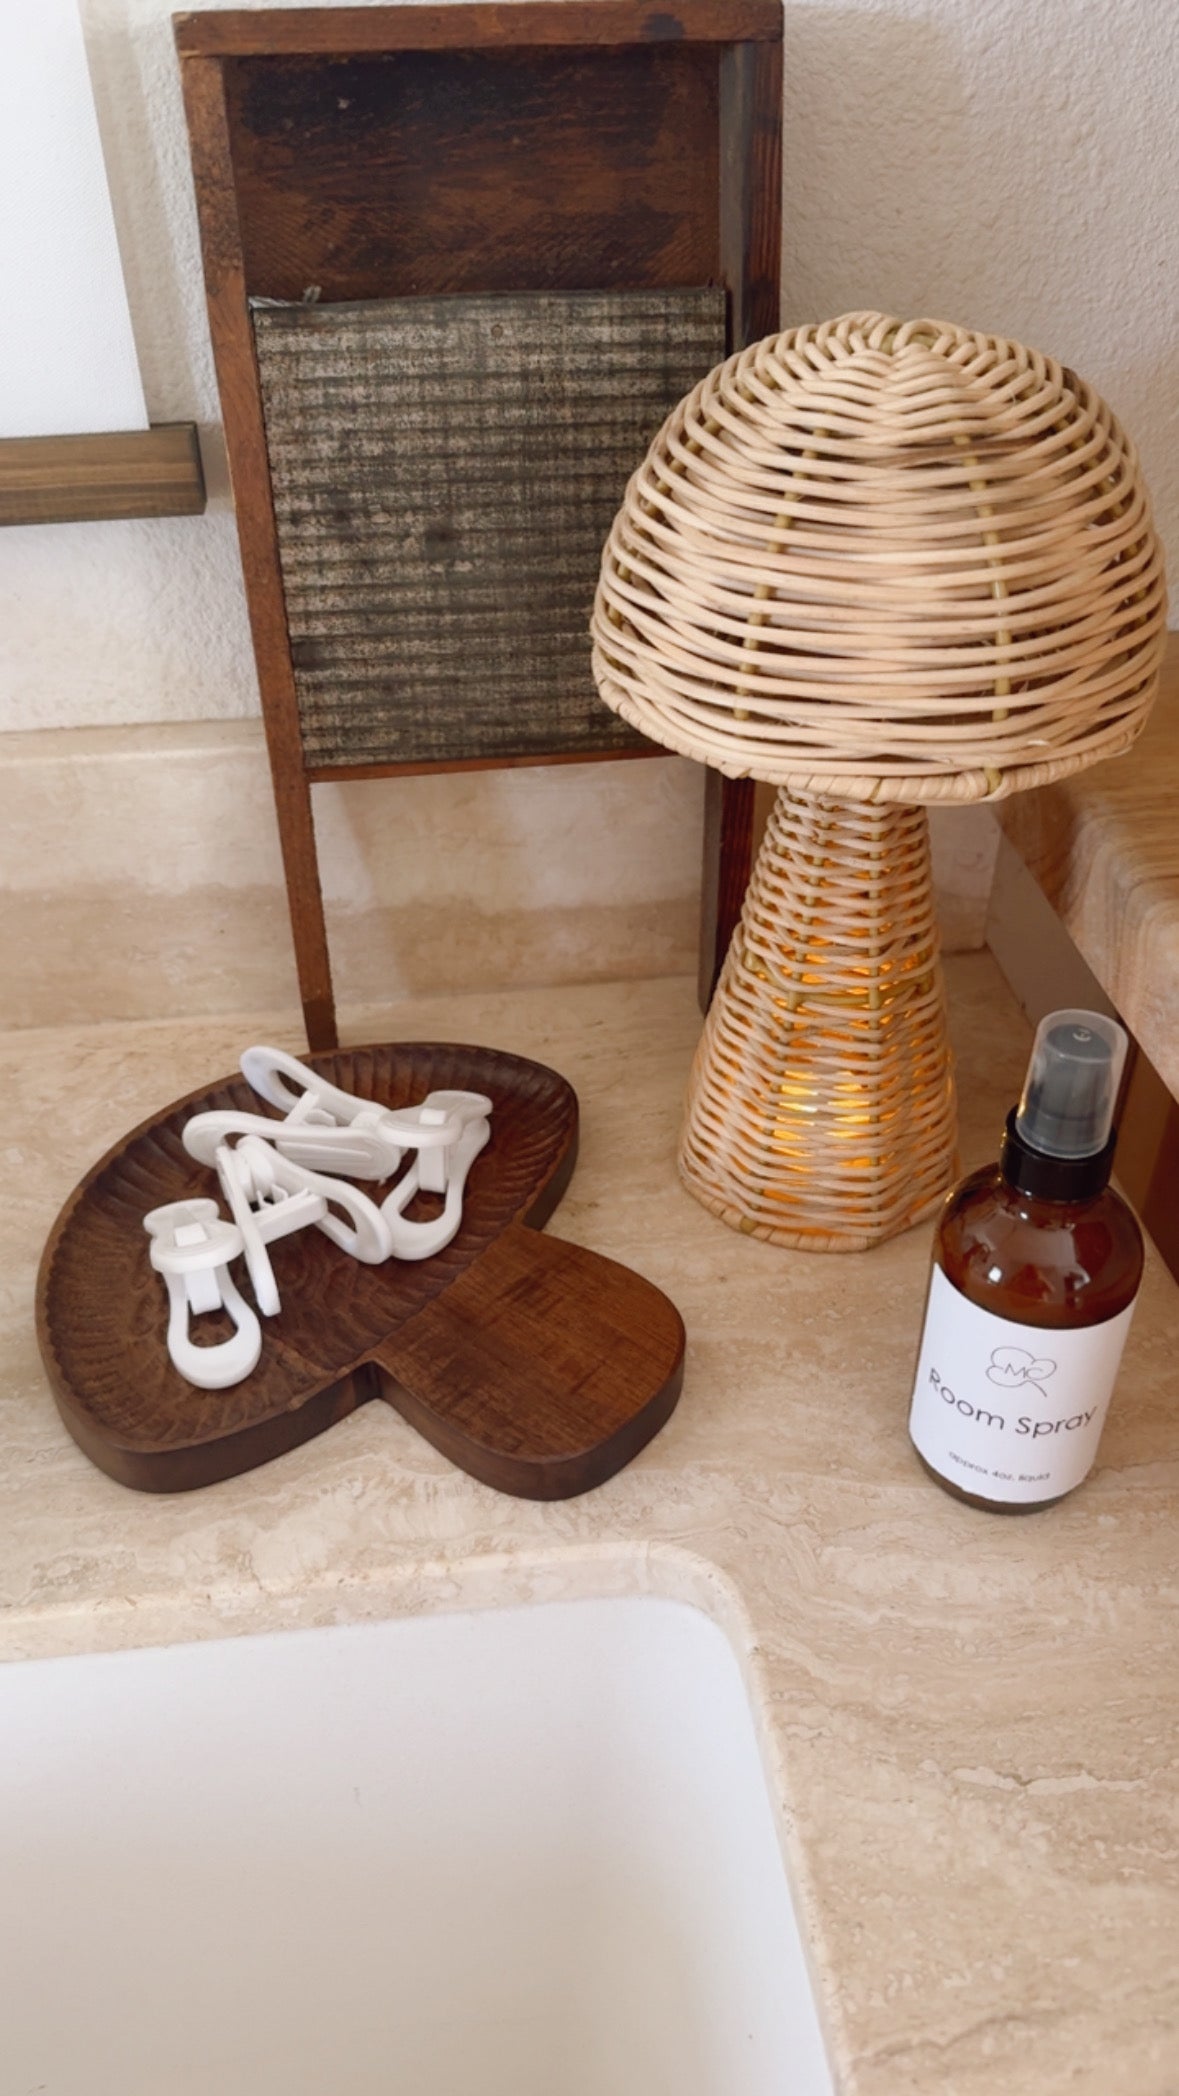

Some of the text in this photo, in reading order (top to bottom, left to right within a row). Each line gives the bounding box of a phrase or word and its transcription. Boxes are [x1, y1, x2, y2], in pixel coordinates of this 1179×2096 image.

[928, 1367, 1097, 1438] Room Spray
[949, 1451, 988, 1475] approx
[1018, 1472, 1050, 1482] liquid
